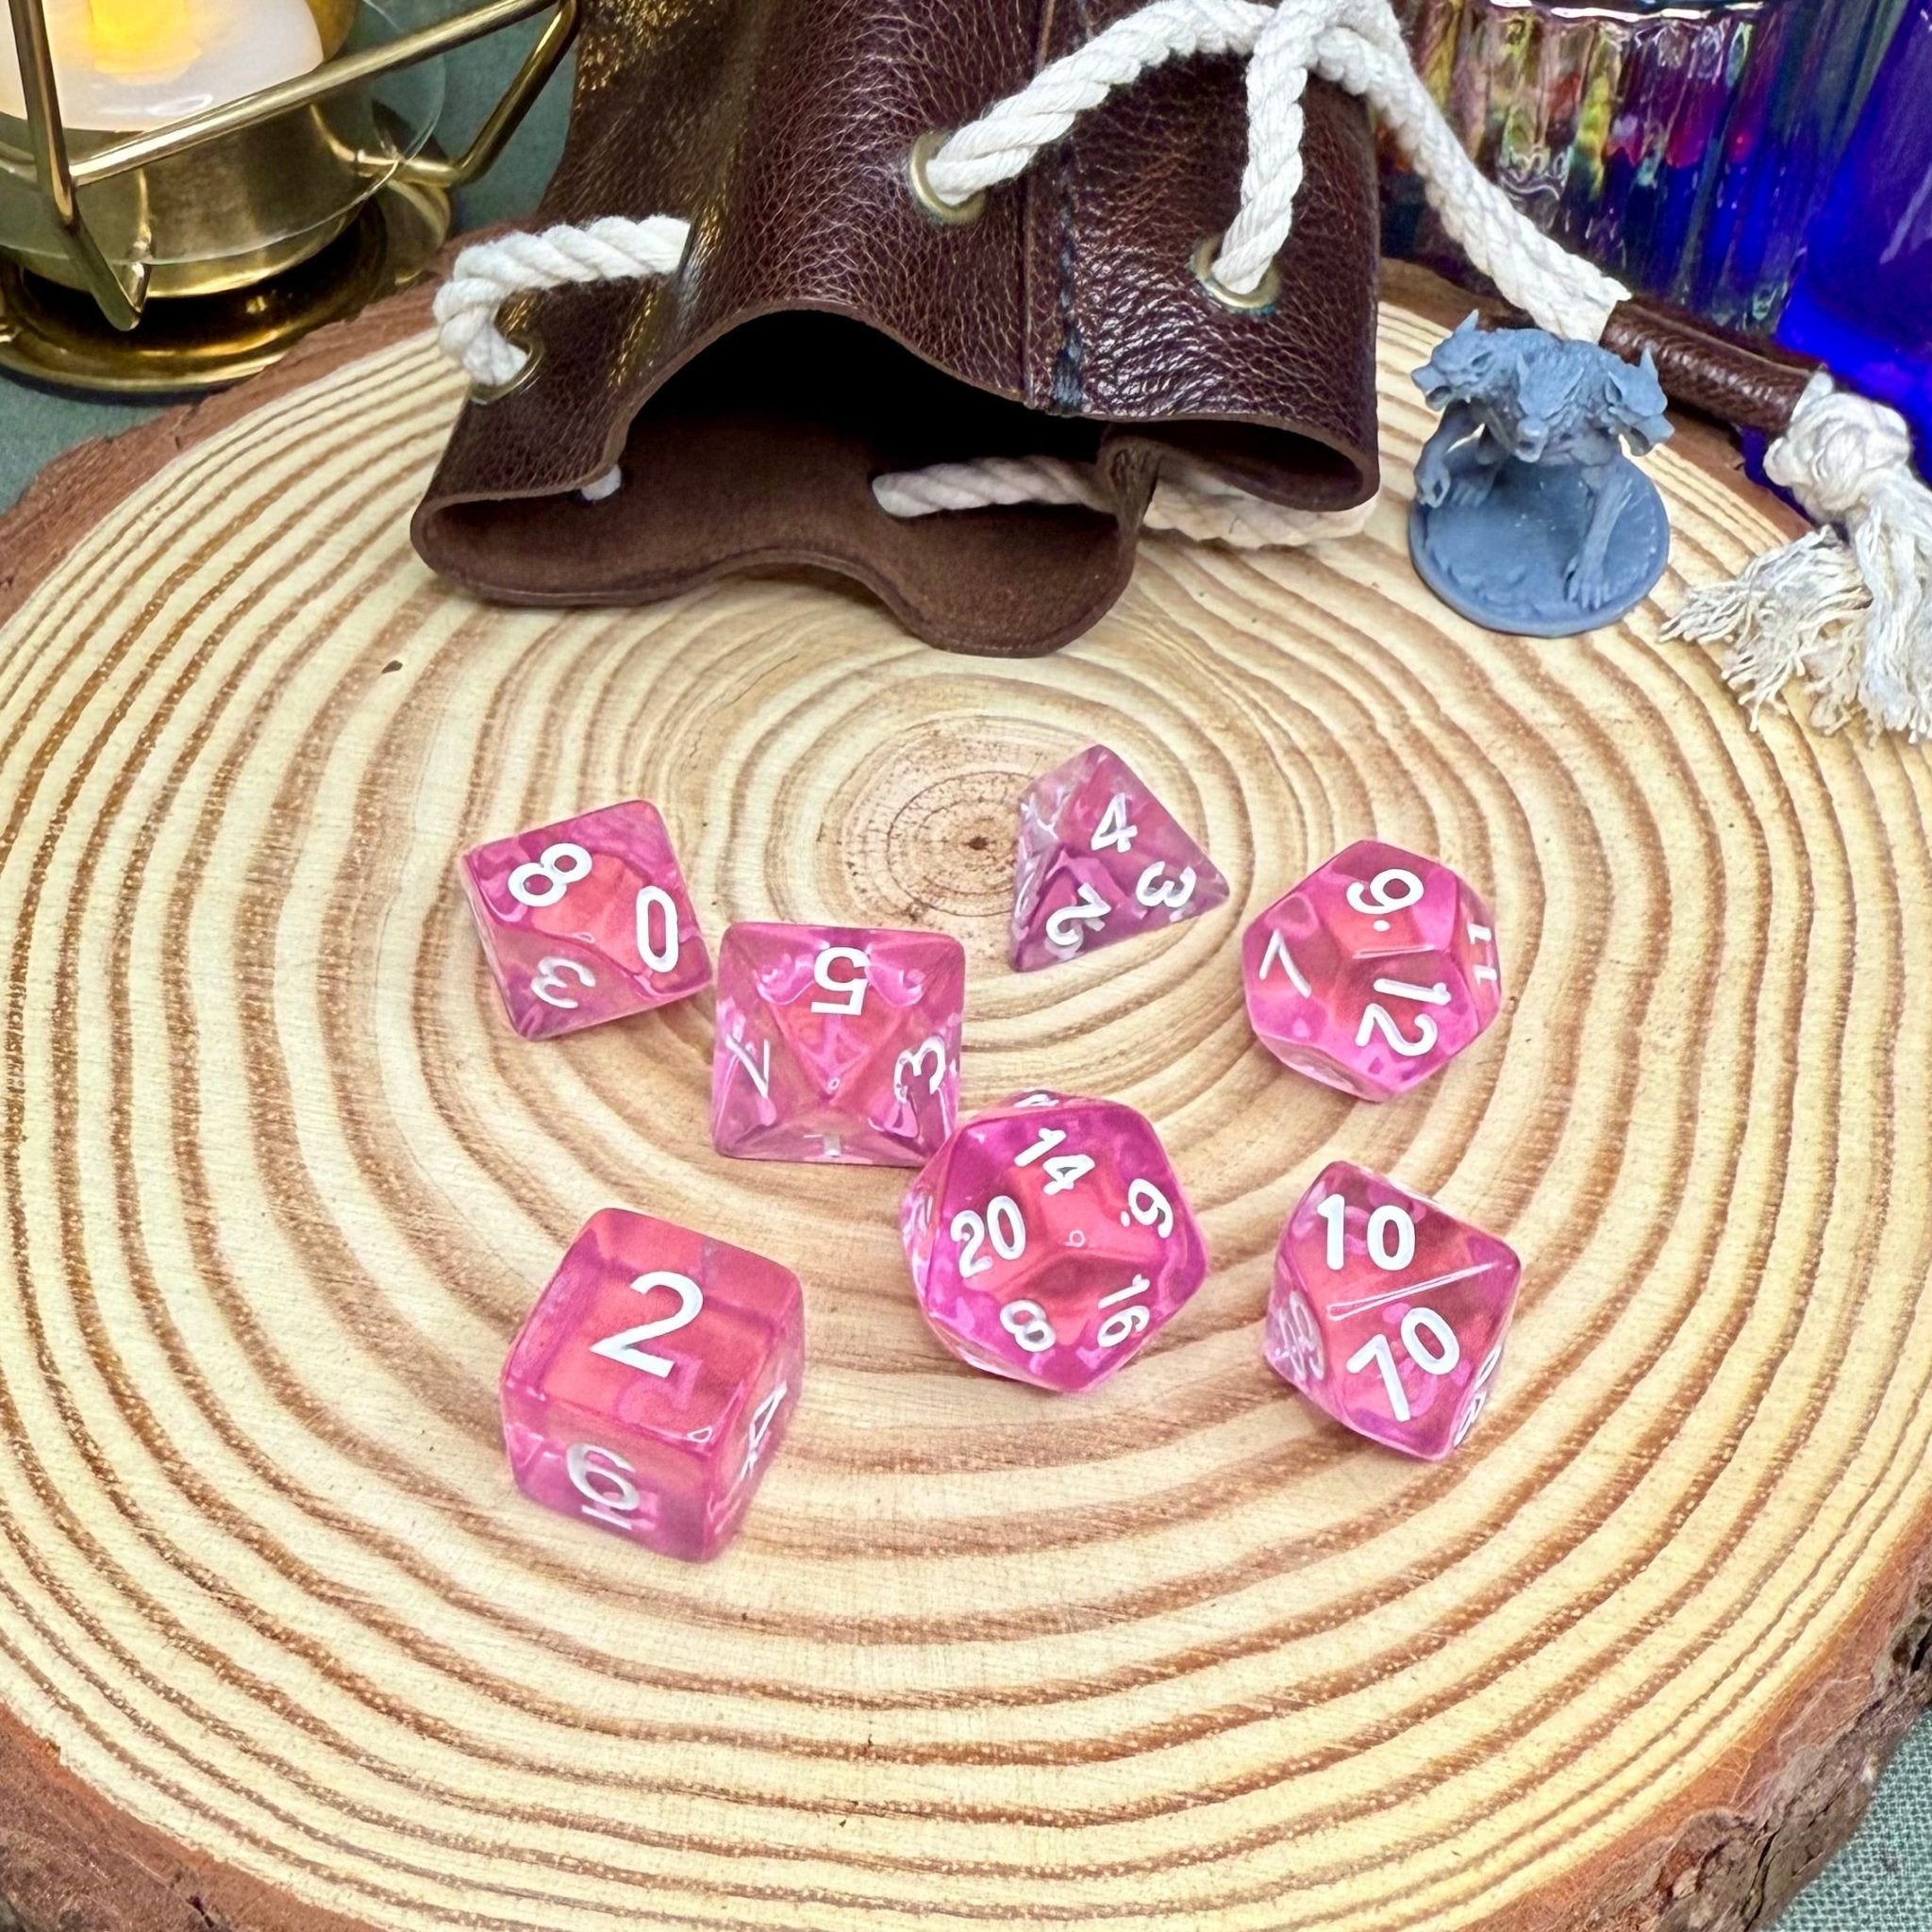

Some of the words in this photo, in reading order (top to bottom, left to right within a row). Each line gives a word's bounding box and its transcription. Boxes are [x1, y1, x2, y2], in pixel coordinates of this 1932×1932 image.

[1091, 791, 1139, 854] 4
[508, 842, 593, 908] 8
[1135, 860, 1197, 908] 3
[635, 885, 679, 974] 0
[1045, 881, 1112, 947] 2
[530, 956, 596, 1009] 3
[810, 946, 872, 1016] 5
[1258, 928, 1312, 999] 7
[1355, 978, 1452, 1057] 12
[893, 1036, 946, 1104] 3
[1014, 1127, 1096, 1196] 14
[950, 1195, 1026, 1278] 20
[1317, 1193, 1416, 1272] 10
[589, 1270, 705, 1379] 2
[999, 1299, 1057, 1353] 8
[1097, 1274, 1151, 1348] 16
[1346, 1307, 1460, 1422] 70
[741, 1379, 789, 1481] 4
